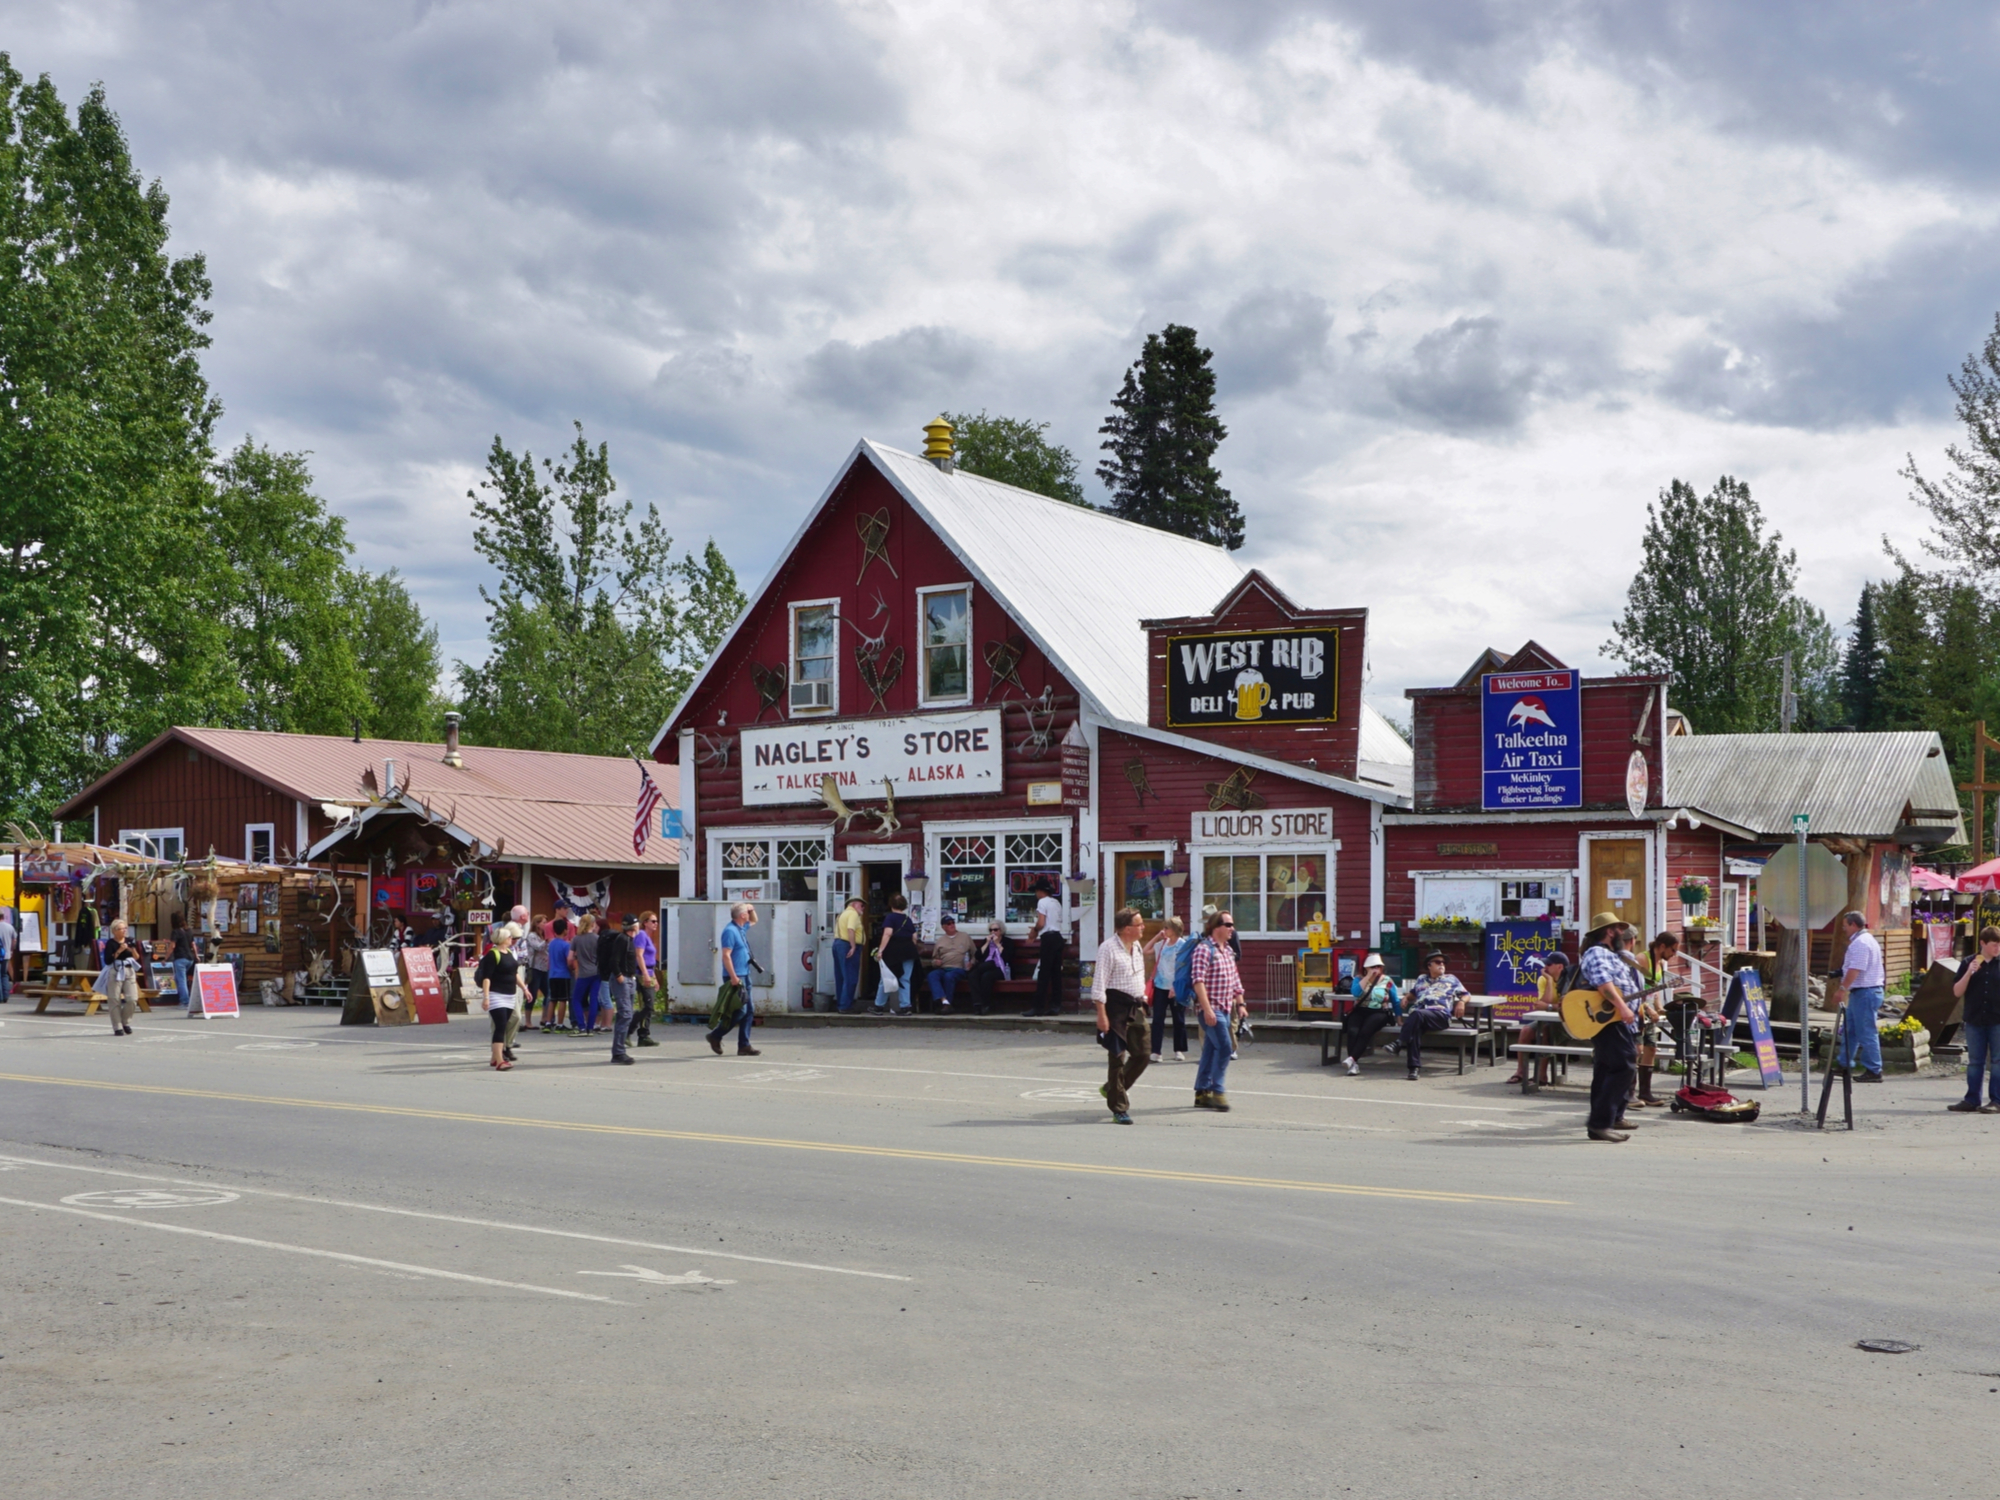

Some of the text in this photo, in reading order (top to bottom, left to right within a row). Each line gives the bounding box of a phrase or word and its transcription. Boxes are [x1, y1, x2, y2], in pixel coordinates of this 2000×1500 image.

[1180, 637, 1325, 685] WEST RIB
[1497, 677, 1542, 689] Welcome
[1190, 692, 1315, 713] DELI & PUB
[837, 723, 855, 731] SINCE
[1495, 731, 1568, 749] Talkeetna
[755, 727, 989, 767] NAGLEY'S STORE
[1500, 751, 1562, 768] Air Taxi
[908, 763, 965, 782] ALASKA
[1510, 772, 1552, 784] McKinley
[1497, 784, 1566, 795] Flightseeing Tours
[1501, 794, 1562, 804] Glacier Landings
[1201, 813, 1327, 838] LIQUOR STORE
[27, 862, 61, 872] ATV
[415, 877, 437, 888] OPEN
[742, 890, 760, 899] ICE
[469, 912, 491, 923] OPEN
[1490, 930, 1556, 954] Talkeetna
[405, 952, 433, 962] Kettle
[1496, 951, 1522, 968] Air
[410, 963, 434, 973] Korn
[1509, 967, 1538, 986] Taxi
[1499, 994, 1539, 1003] cKinle
